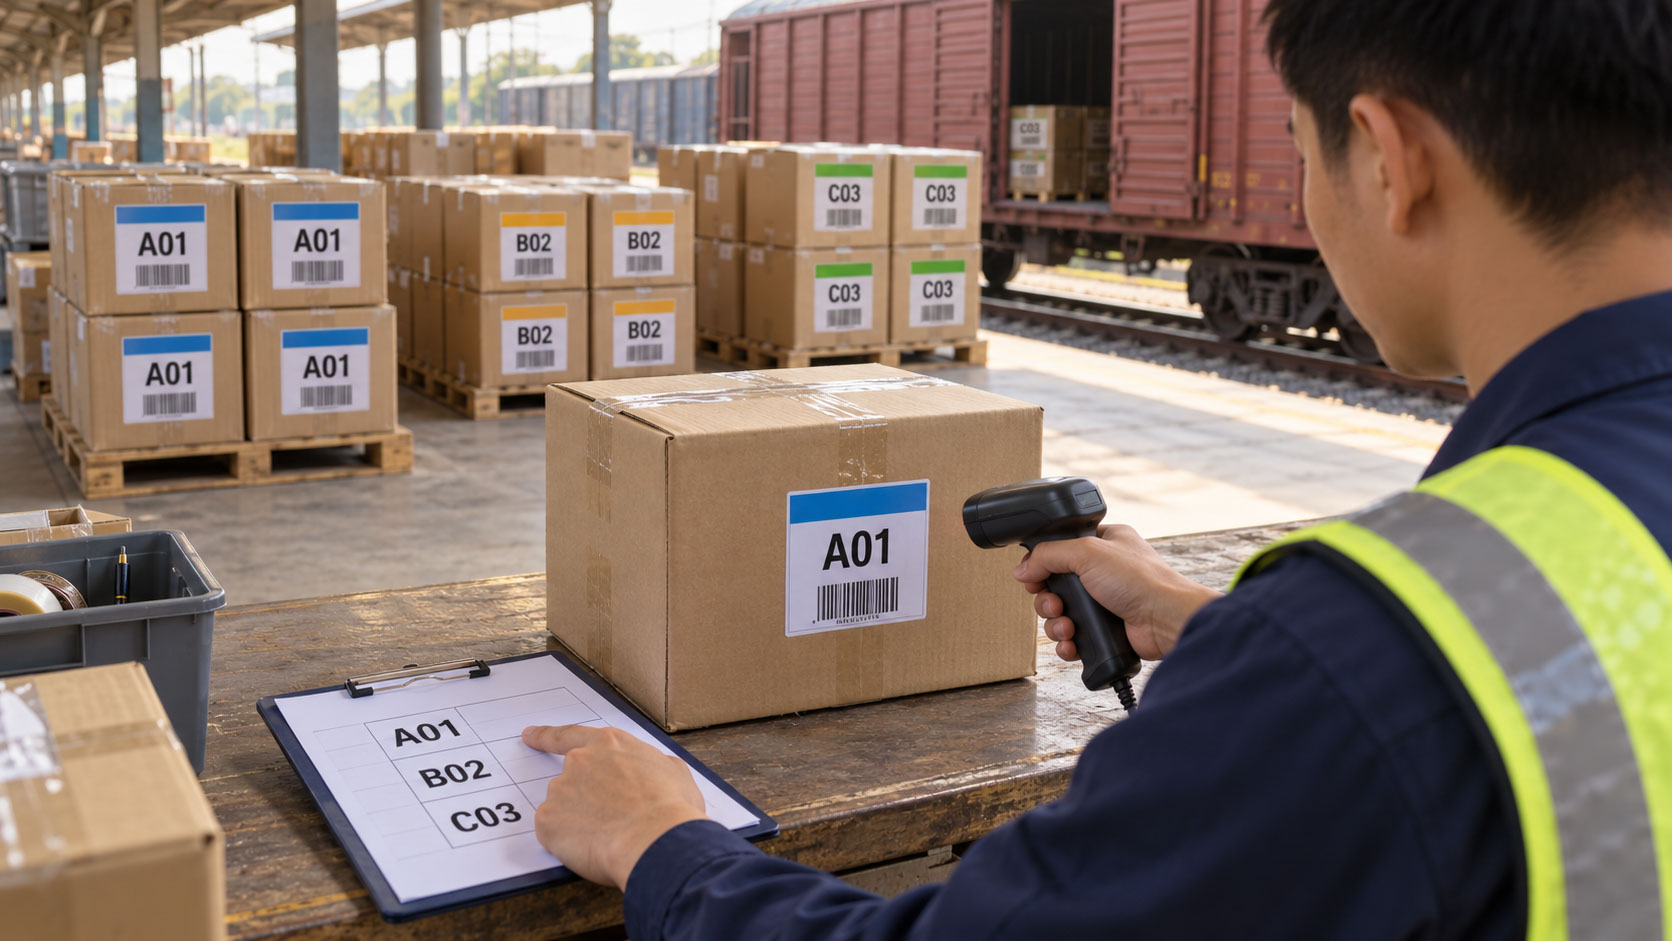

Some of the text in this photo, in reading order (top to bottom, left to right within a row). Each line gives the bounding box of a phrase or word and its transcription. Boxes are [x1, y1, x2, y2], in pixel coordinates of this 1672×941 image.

[1020, 122, 1040, 134] C03
[828, 184, 861, 202] C03
[925, 184, 956, 202] C03
[137, 231, 187, 256] A01
[293, 228, 341, 252] A01
[516, 233, 551, 252] B02
[627, 231, 661, 249] B02
[828, 284, 861, 303] C03
[922, 280, 953, 299] C03
[517, 325, 553, 345] B02
[627, 320, 661, 339] B02
[145, 361, 193, 386] A01
[302, 354, 349, 379] A01
[822, 528, 889, 570] A01
[394, 719, 461, 748] A01
[418, 759, 492, 789] B02
[450, 802, 522, 833] C03
